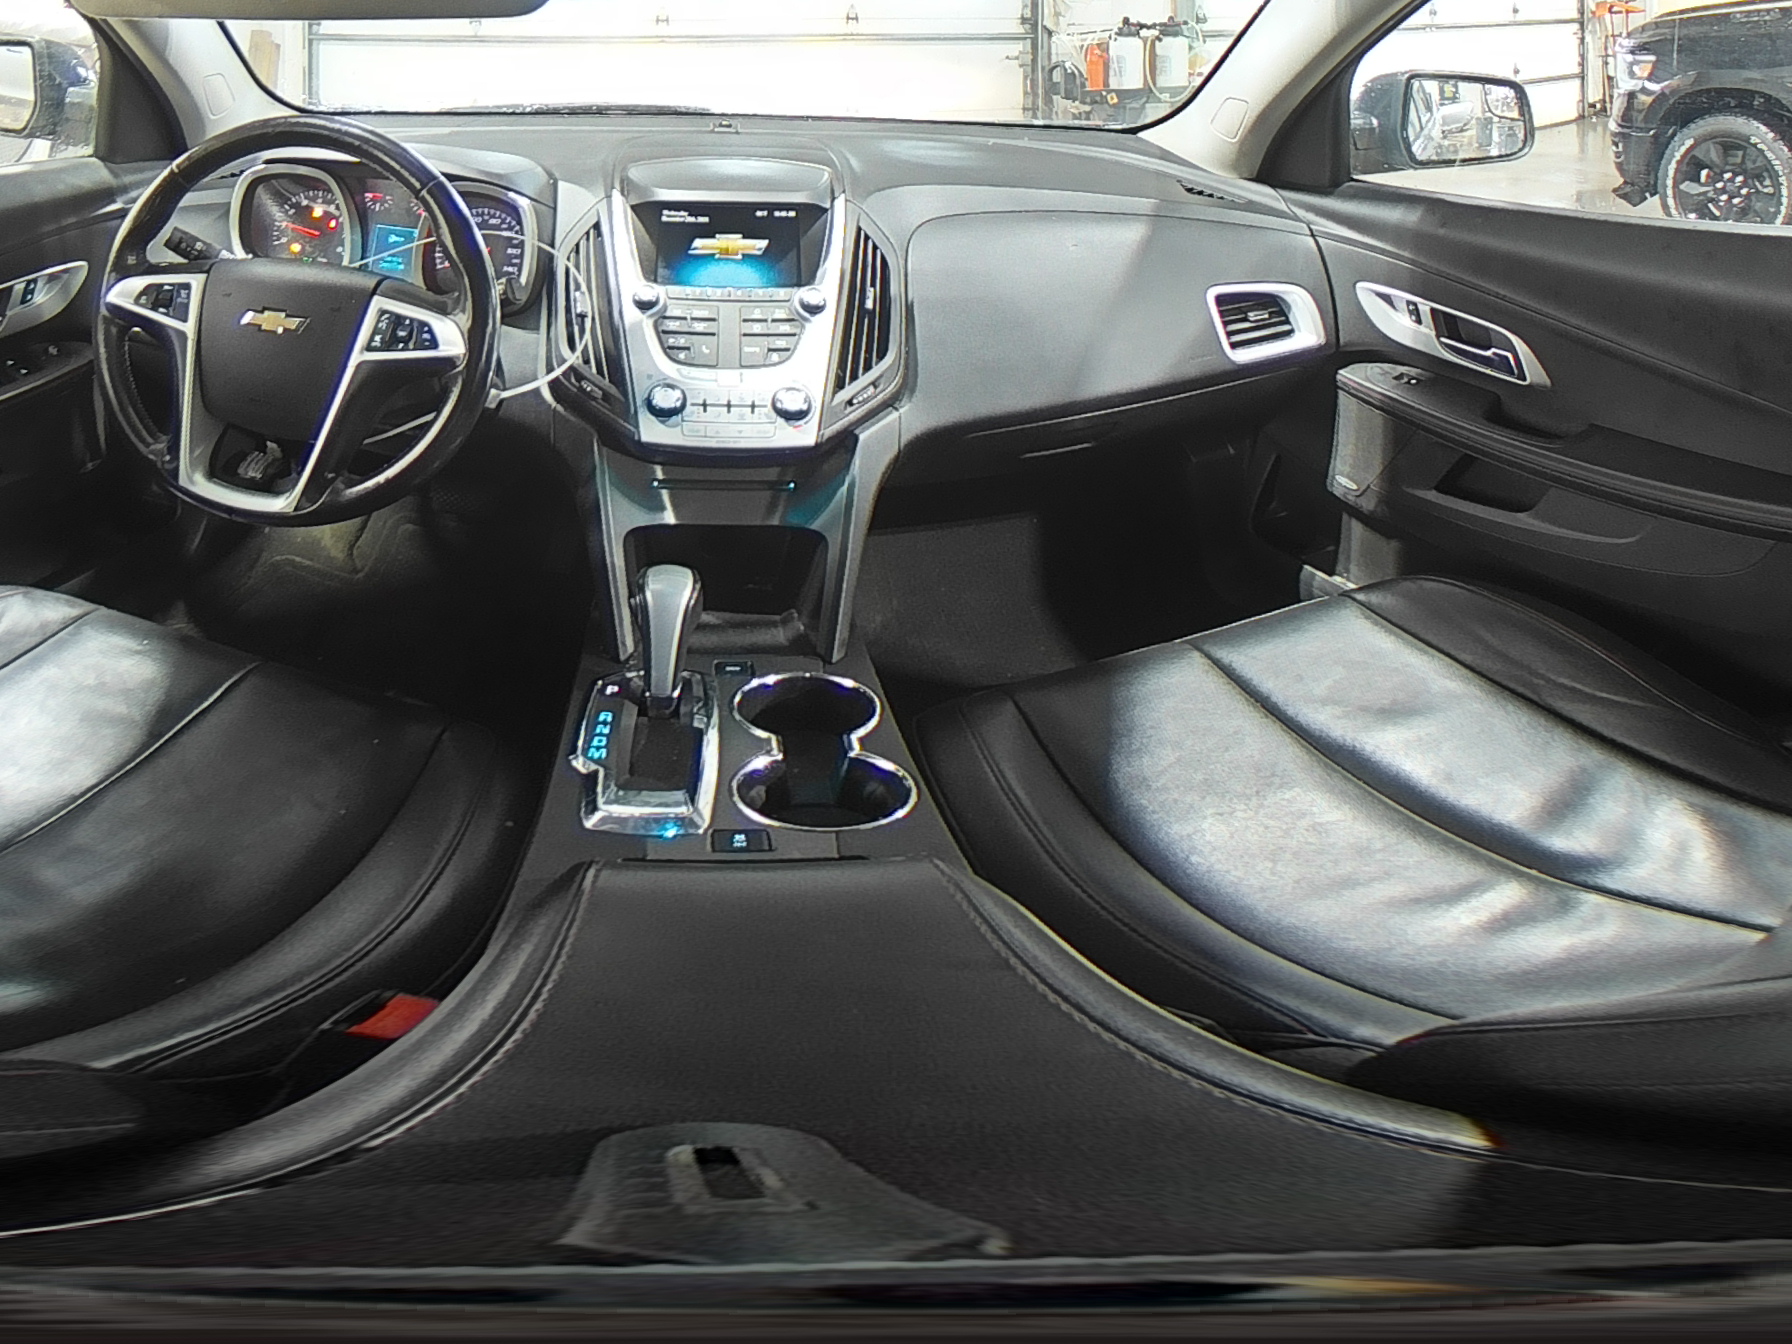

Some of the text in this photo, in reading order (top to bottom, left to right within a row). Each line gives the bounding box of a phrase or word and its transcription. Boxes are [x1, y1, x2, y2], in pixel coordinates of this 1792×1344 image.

[605, 685, 619, 695] P
[598, 711, 613, 723] R
[593, 724, 611, 735] N
[591, 736, 607, 747] D
[587, 747, 607, 760] M
